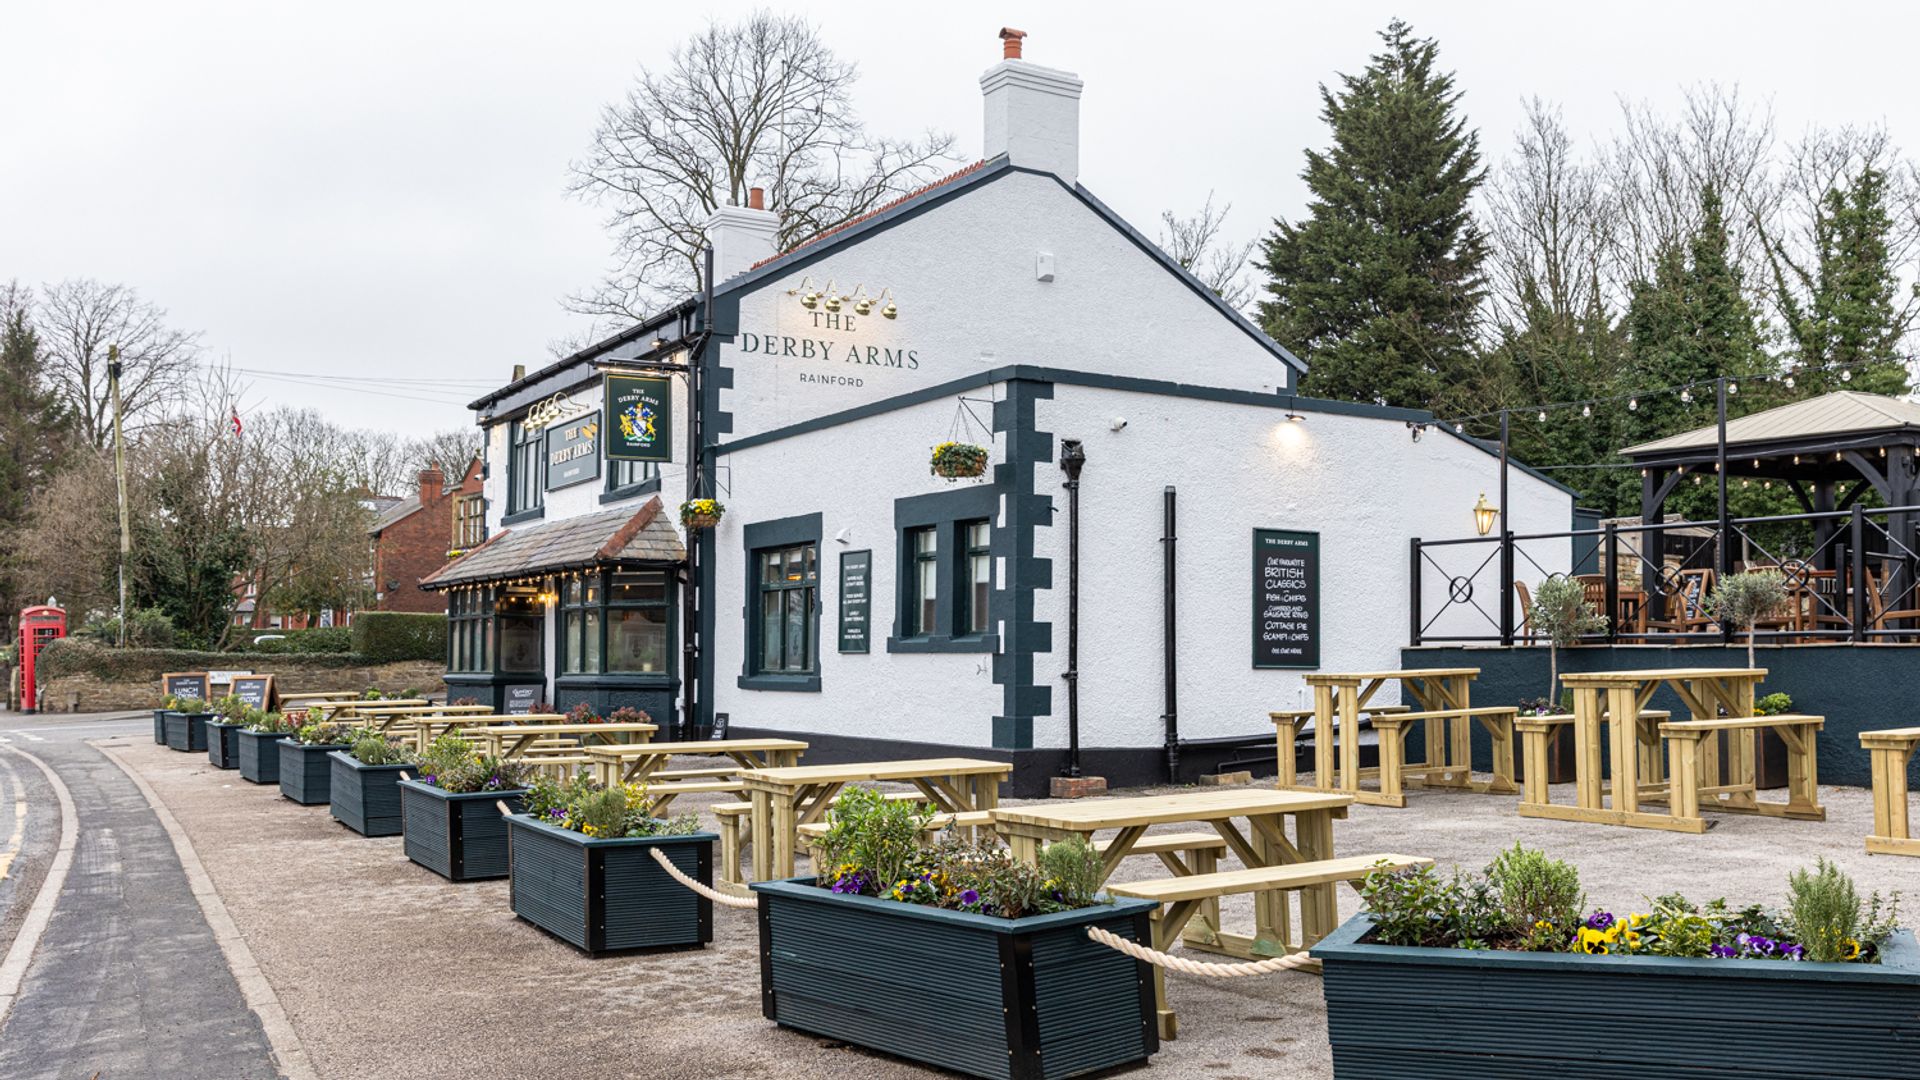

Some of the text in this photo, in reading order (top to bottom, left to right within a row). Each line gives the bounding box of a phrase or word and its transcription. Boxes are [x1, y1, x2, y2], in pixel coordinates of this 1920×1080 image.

[808, 311, 857, 332] THE
[740, 332, 919, 370] DERBY ARMS
[799, 372, 864, 388] RAINFORD
[617, 395, 659, 406] DERBY ARMS
[1265, 567, 1304, 578] BRITISH
[1265, 579, 1306, 589] CLASSICS
[1265, 593, 1280, 602] FISH
[1265, 621, 1294, 630] COTTAGE
